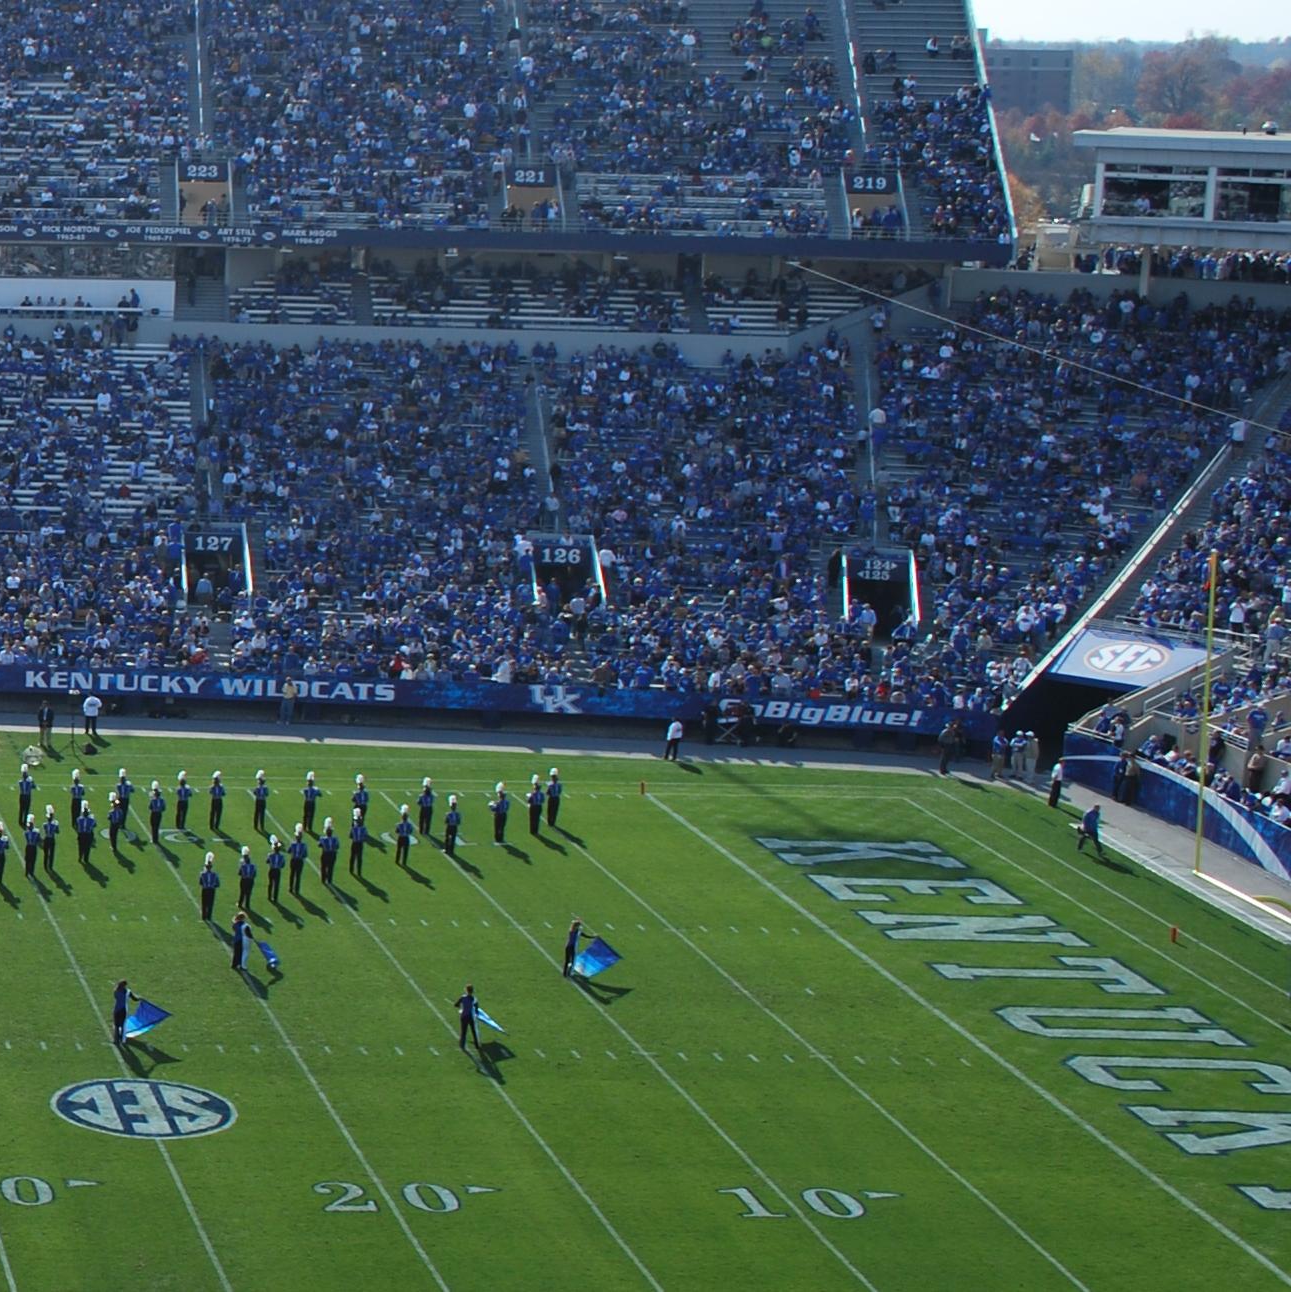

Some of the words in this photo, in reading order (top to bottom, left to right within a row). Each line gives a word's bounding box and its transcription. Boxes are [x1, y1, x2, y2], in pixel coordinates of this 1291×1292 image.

[187, 165, 218, 177] 223
[515, 170, 545, 183] 221
[853, 176, 886, 189] 219
[63, 225, 100, 233] NORTON
[126, 226, 142, 235] JOE
[145, 226, 191, 235] FEDERSPIEL
[217, 228, 233, 236] ART
[235, 228, 256, 236] STILL
[194, 536, 233, 551] 127
[541, 548, 581, 564] 126
[864, 560, 892, 570] 124
[863, 571, 890, 581] 125
[1090, 644, 1164, 672] SEC
[25, 671, 207, 694] KENTUCKY
[220, 677, 395, 701] WILDCATS
[528, 684, 582, 714] UK
[755, 837, 1291, 1209] KENTUCK
[312, 1181, 462, 1214] 20
[717, 1186, 866, 1219] 10
